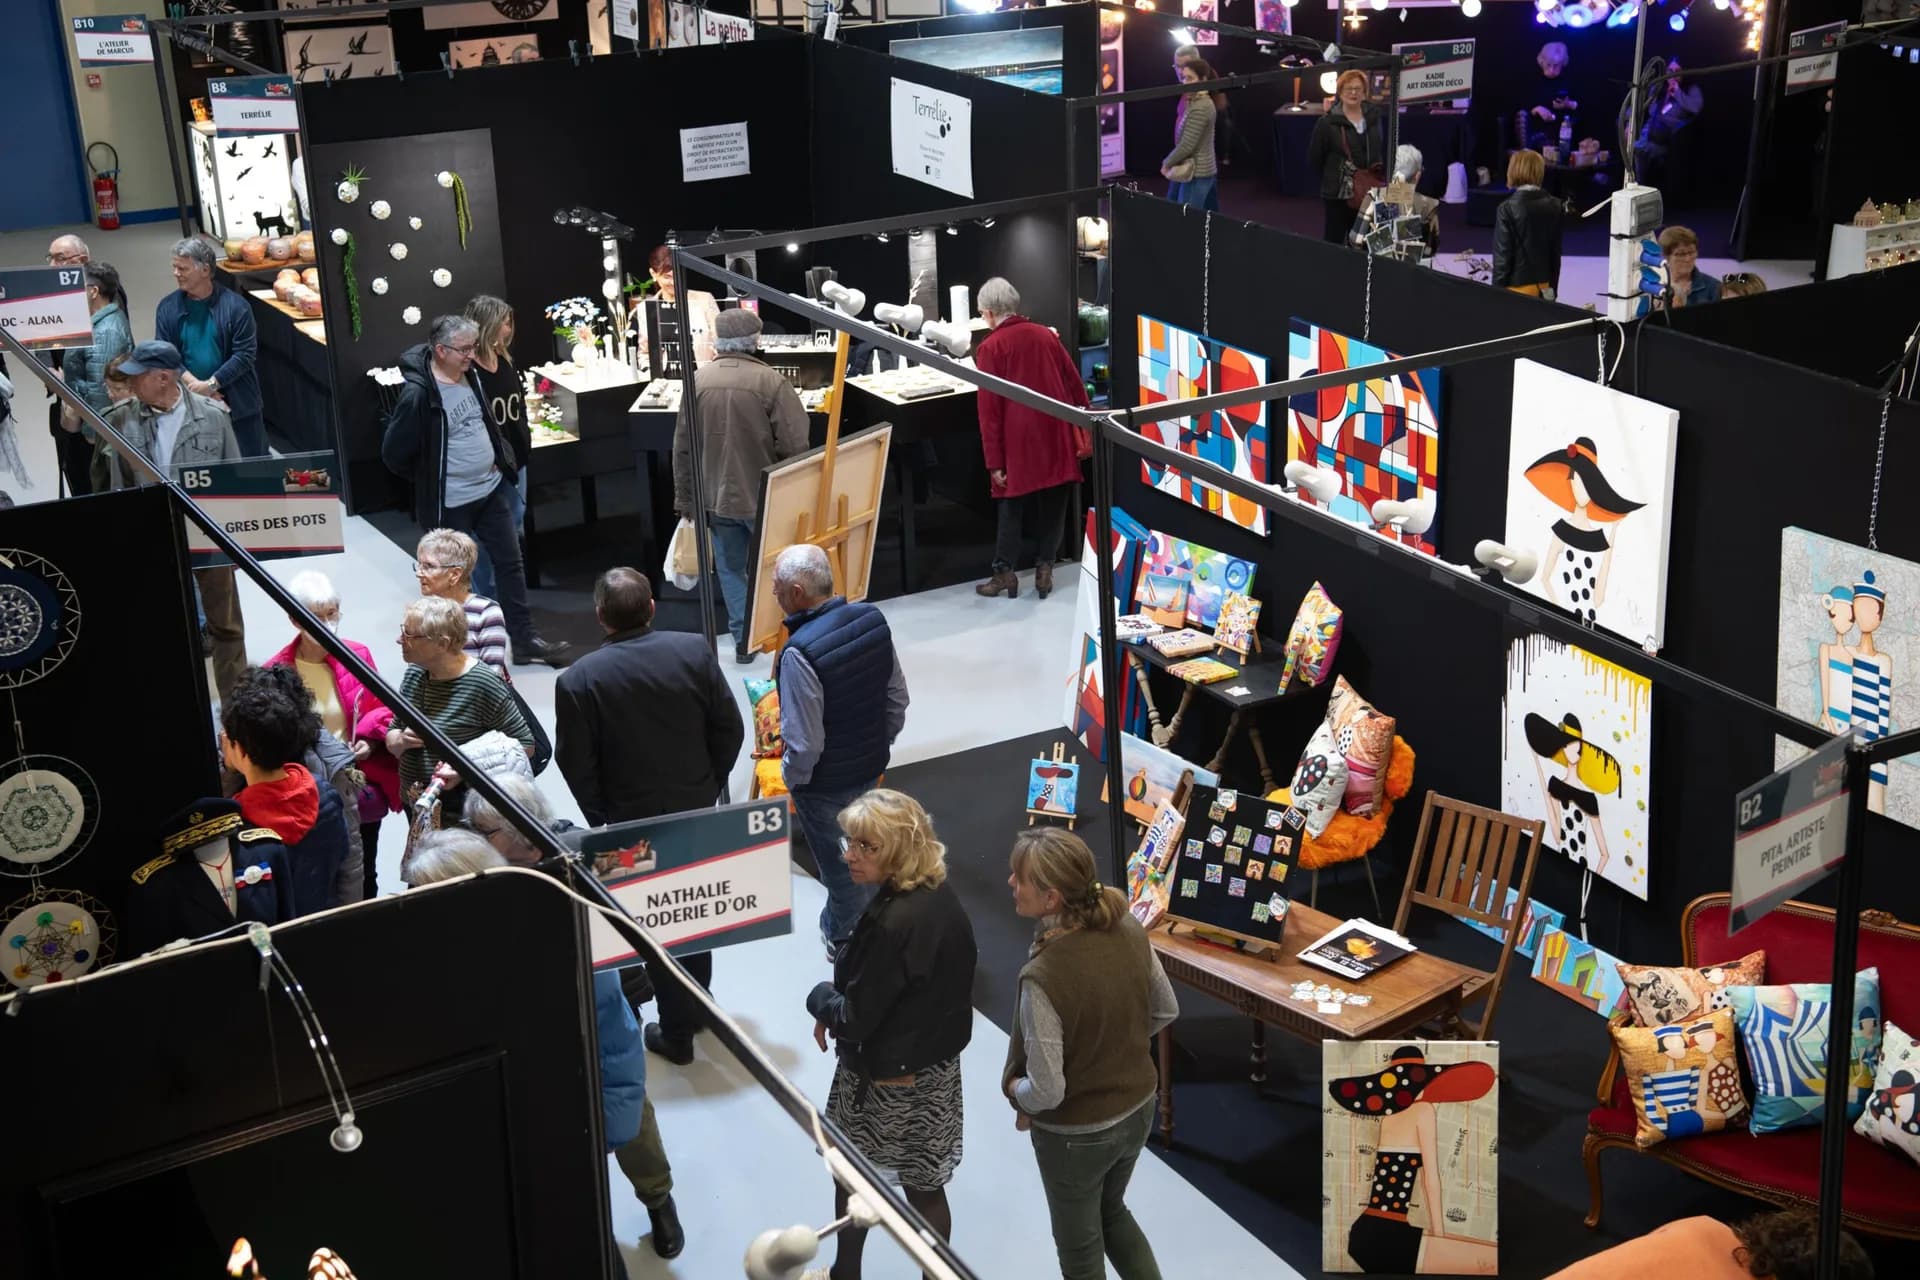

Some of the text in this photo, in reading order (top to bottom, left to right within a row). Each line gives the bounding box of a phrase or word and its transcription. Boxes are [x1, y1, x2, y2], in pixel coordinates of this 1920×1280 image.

[74, 18, 95, 29] B10
[705, 14, 748, 42] La petite
[99, 40, 130, 48] L'ATELIER
[106, 47, 134, 55] MARCUS
[1452, 42, 1472, 55] B20
[1406, 81, 1419, 90] ART
[1420, 80, 1444, 89] DESIGN
[1425, 72, 1445, 80] KADIE
[211, 82, 227, 94] B8
[912, 95, 948, 123] Terrélie
[59, 270, 80, 286] B7
[28, 315, 63, 326] ALANA
[183, 469, 212, 489] B5
[225, 513, 327, 533] GRES DES POTS
[1740, 793, 1762, 825] B2
[747, 807, 783, 835] B3
[1760, 815, 1826, 868] PITA ARTISTE
[1771, 841, 1813, 879] PEINTRE
[647, 880, 732, 909] NATHALIE
[715, 894, 758, 916] D'OR
